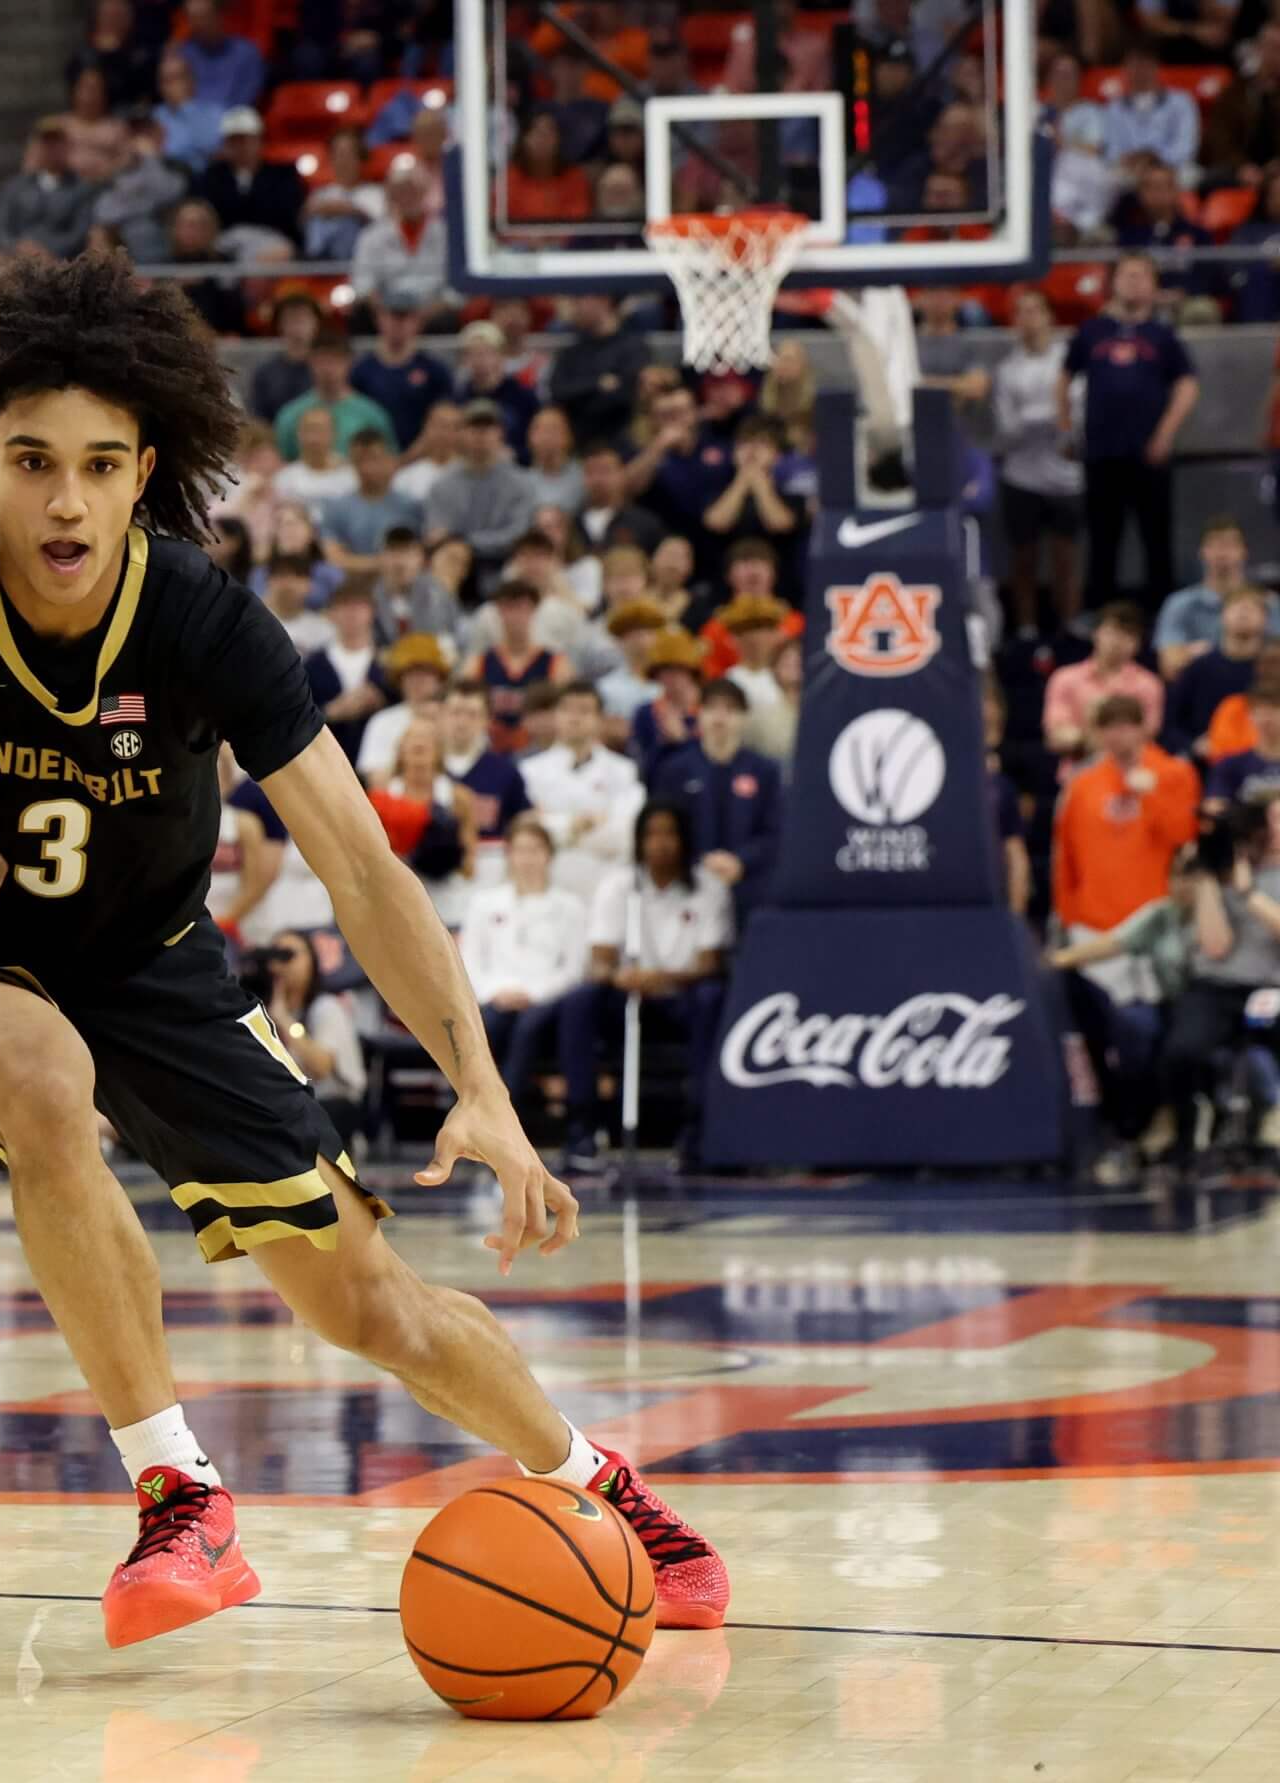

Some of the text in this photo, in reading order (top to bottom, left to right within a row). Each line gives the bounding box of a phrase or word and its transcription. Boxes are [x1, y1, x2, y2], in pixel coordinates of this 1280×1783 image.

[113, 731, 141, 758] SEC
[13, 798, 91, 898] 3
[721, 991, 1026, 1088] Coca-Cola
